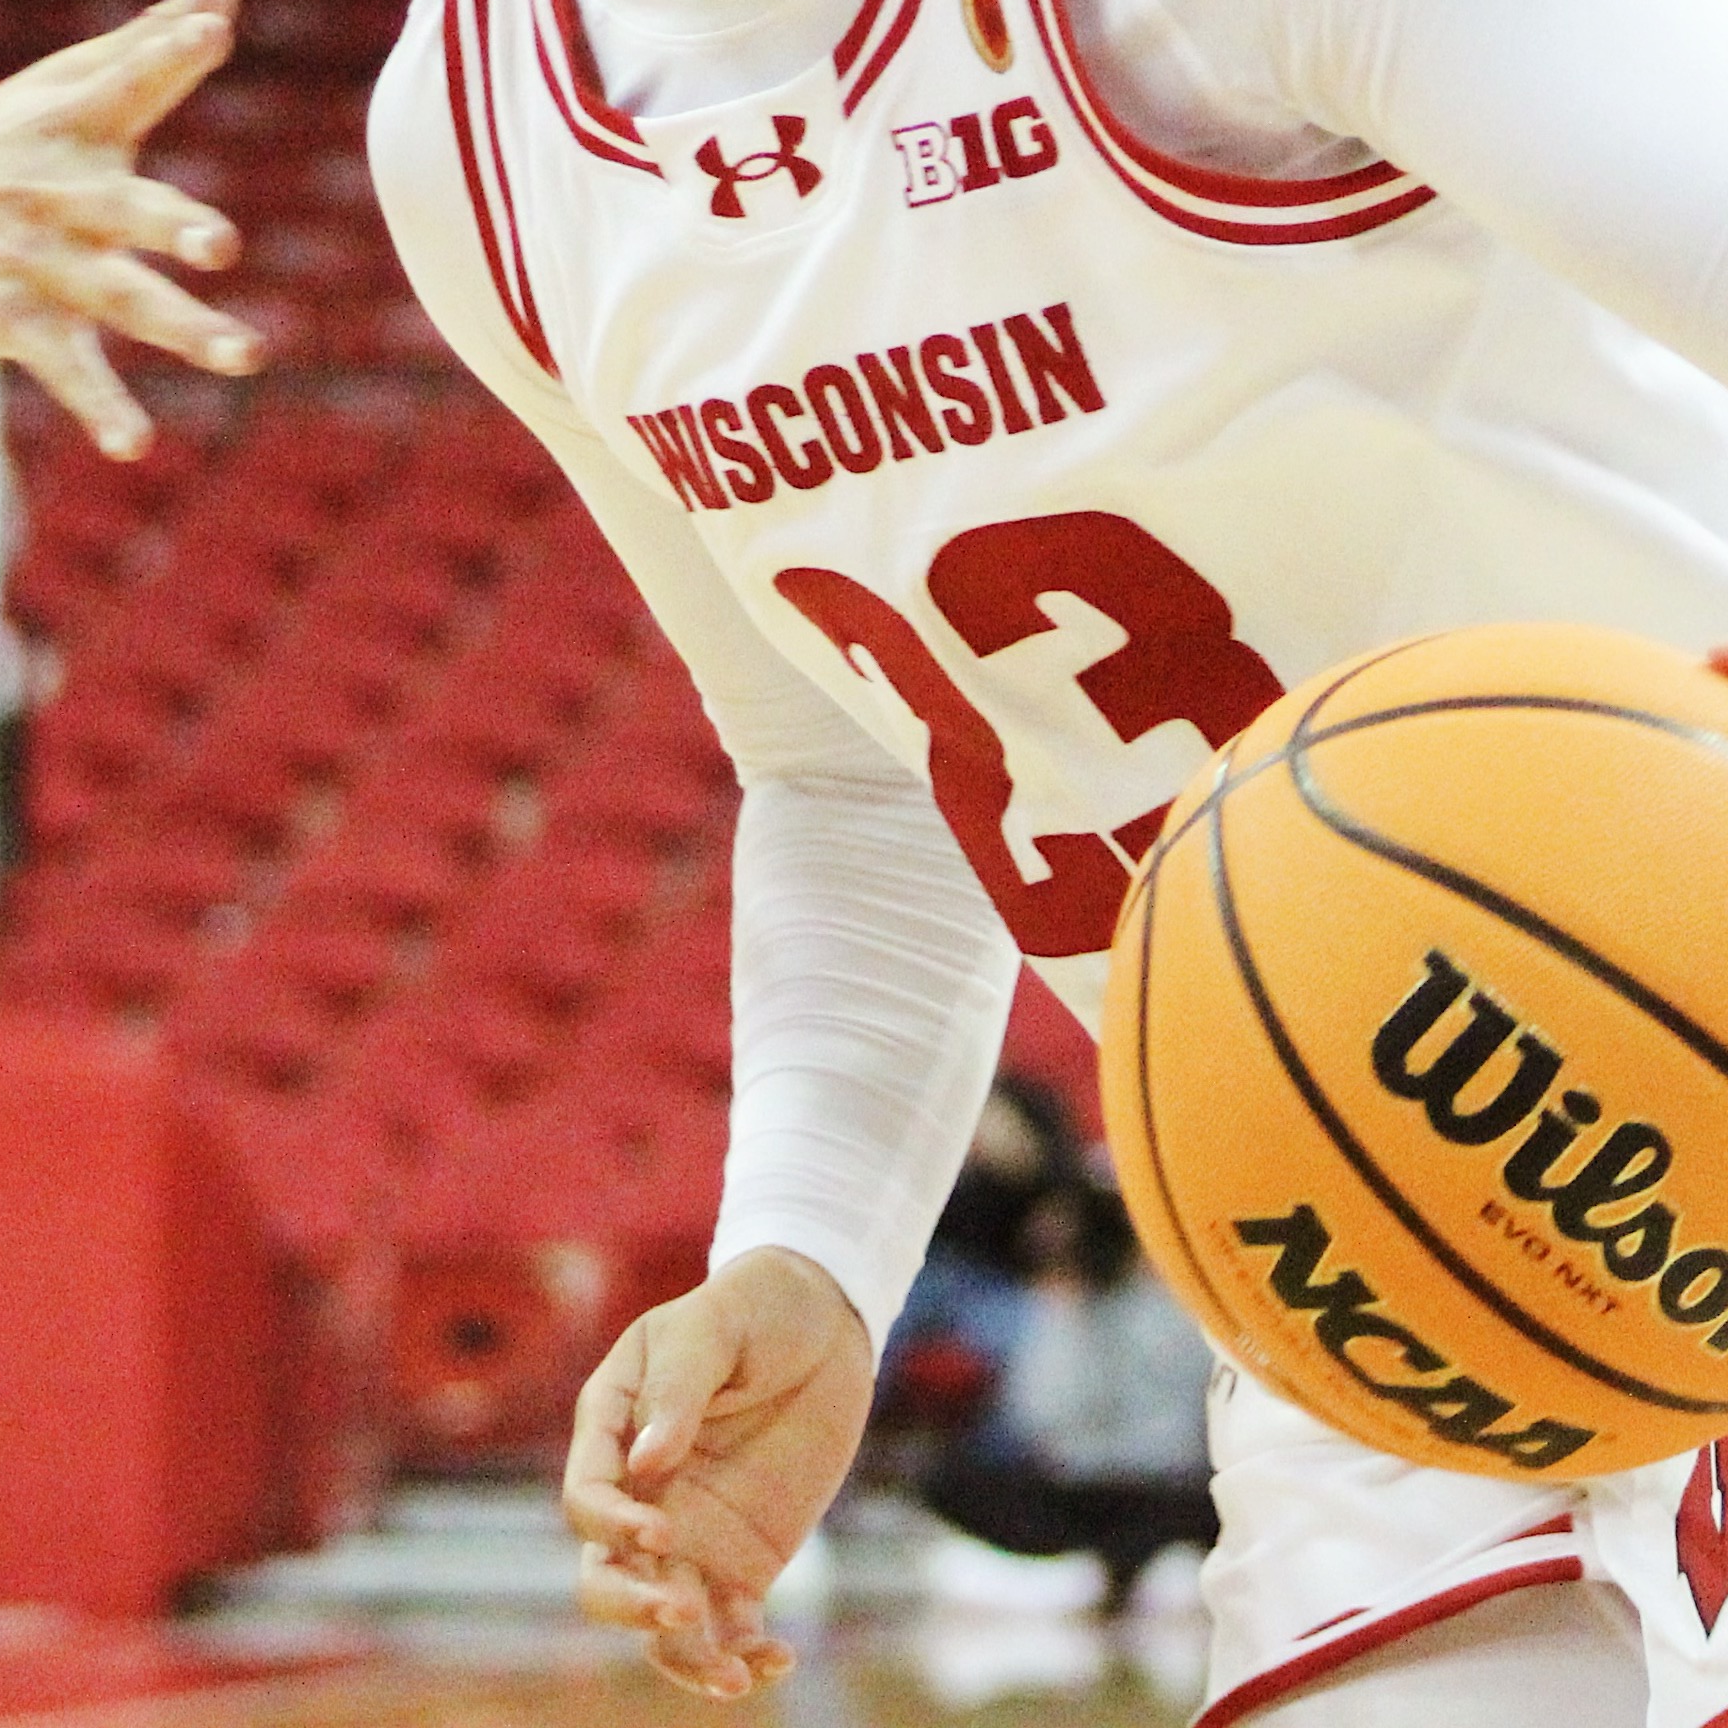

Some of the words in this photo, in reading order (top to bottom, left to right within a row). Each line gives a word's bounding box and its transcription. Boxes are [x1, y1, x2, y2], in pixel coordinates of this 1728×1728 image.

[627, 301, 1107, 513] WISCONSIN
[773, 510, 1288, 958] 23
[1231, 1203, 1598, 1469] NCAA
[1480, 1199, 1550, 1262] EVO
[1553, 1262, 1619, 1315] NXT
